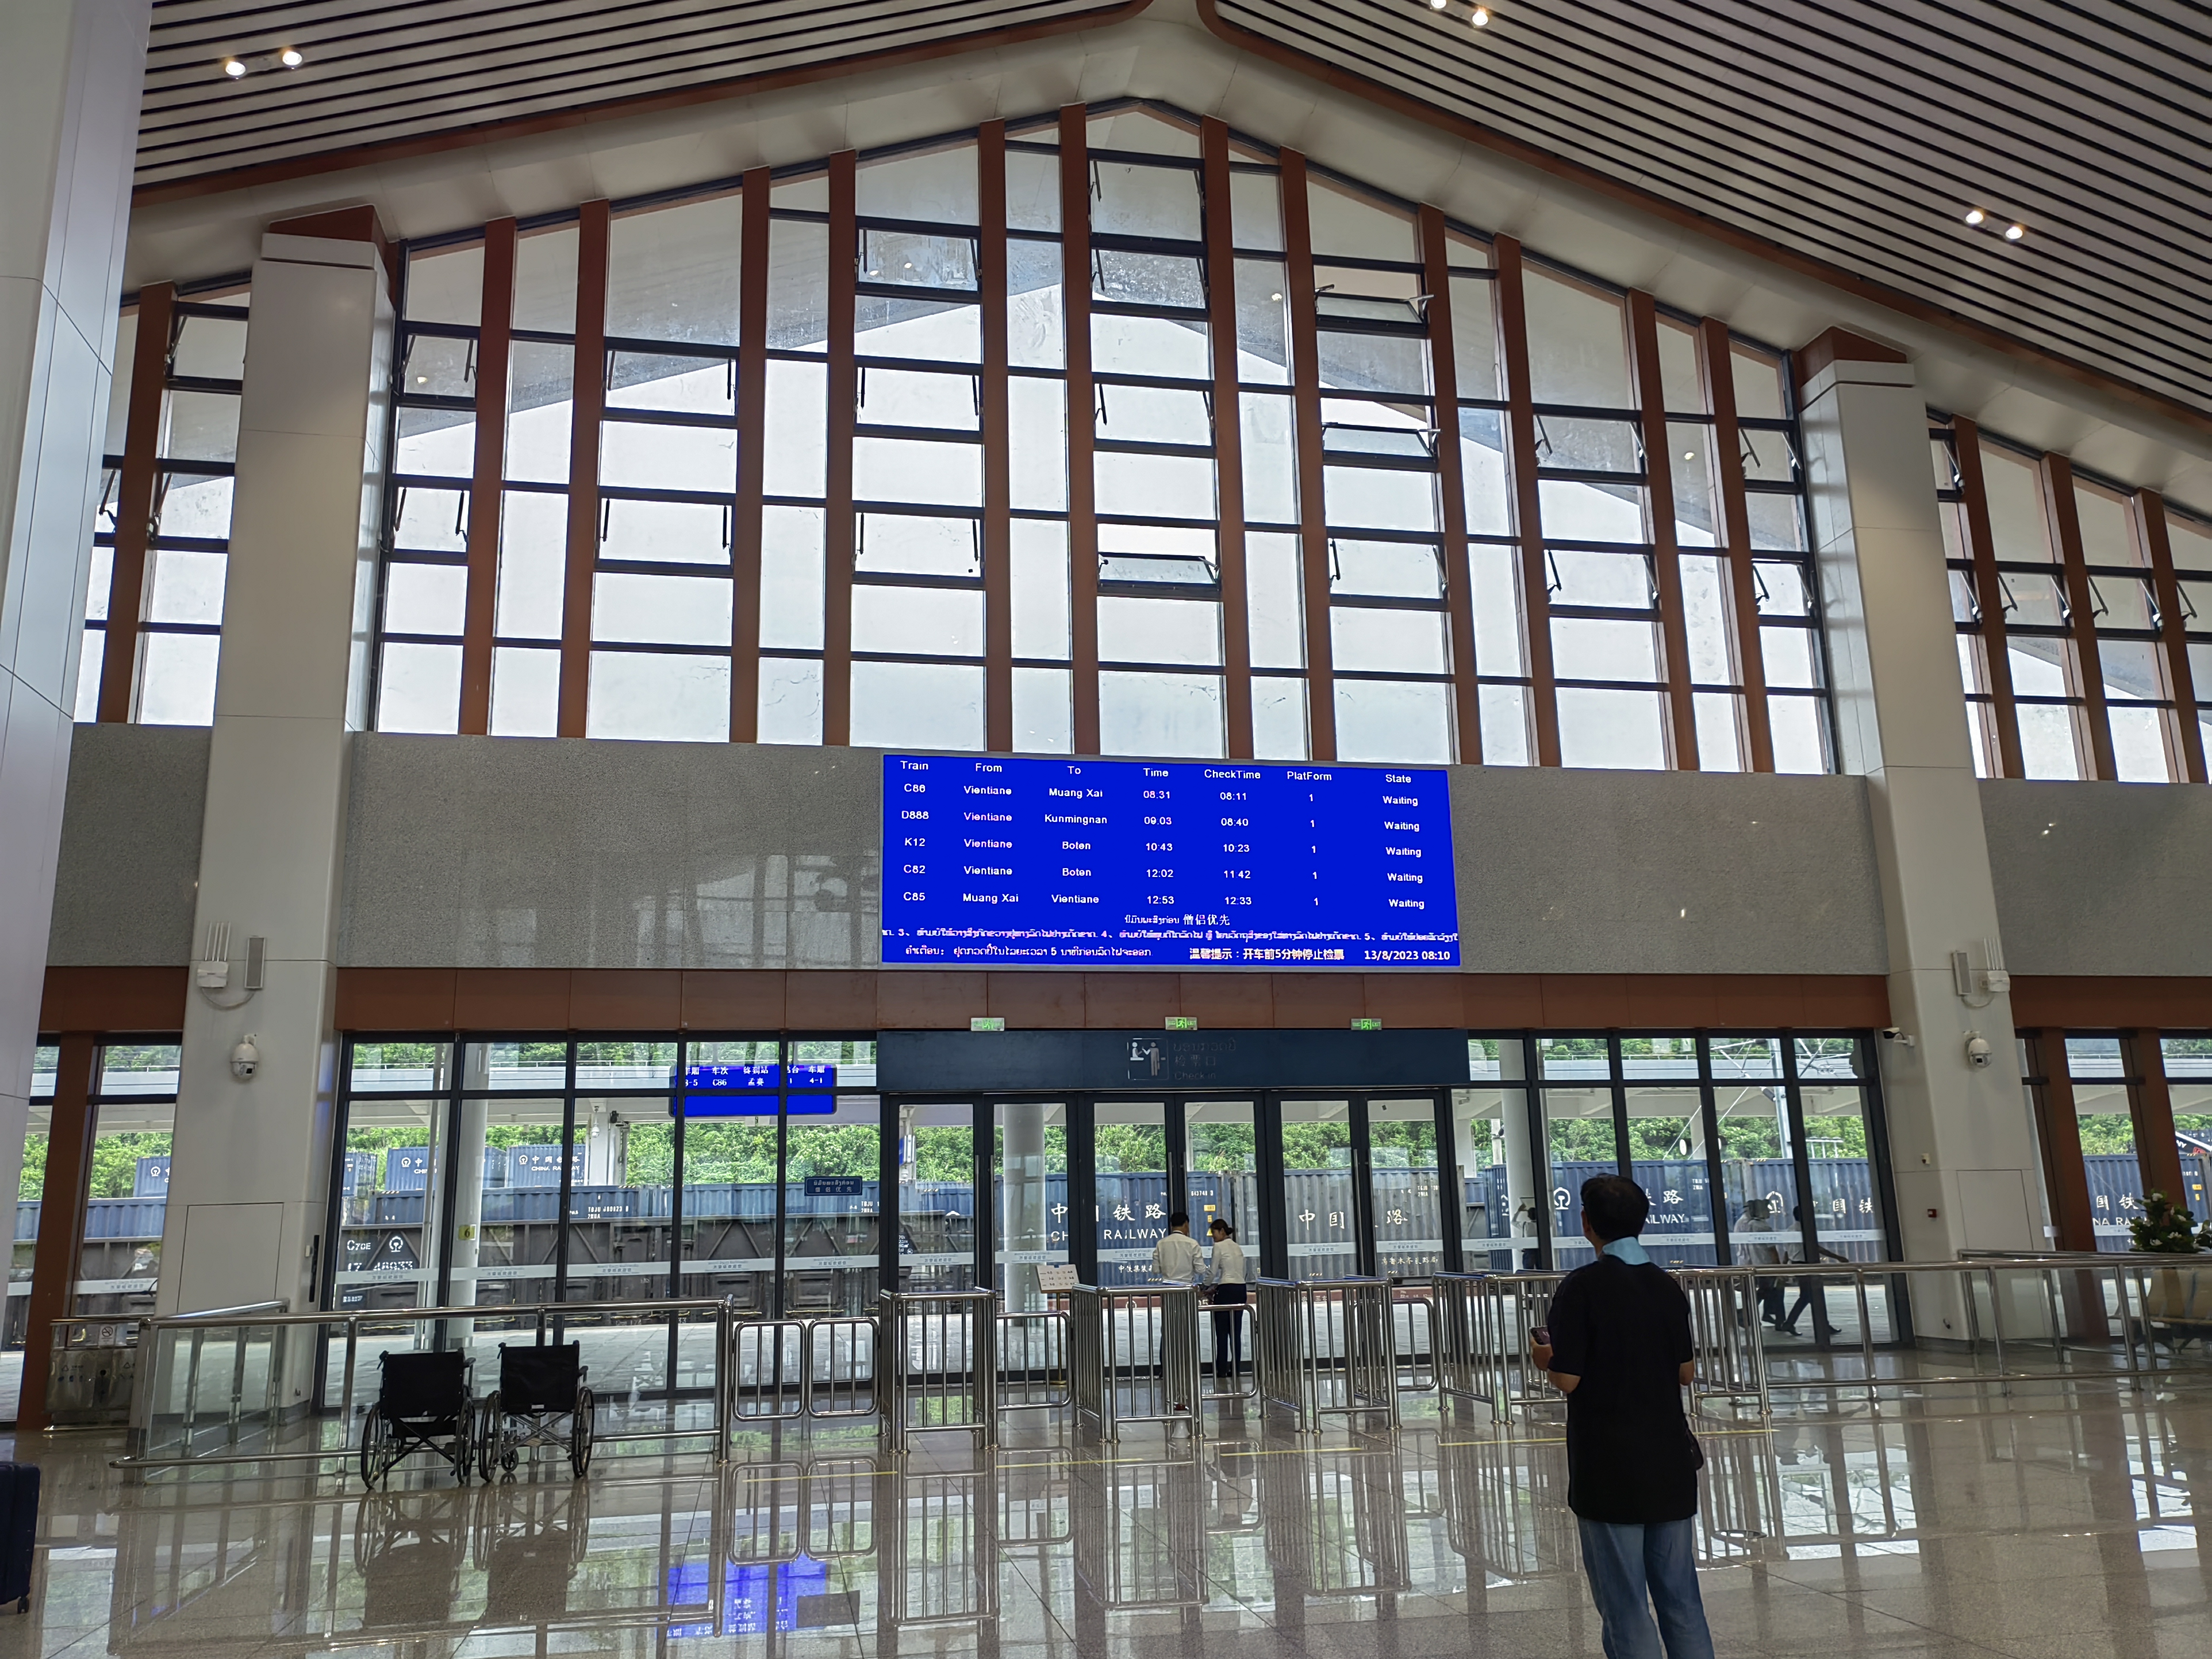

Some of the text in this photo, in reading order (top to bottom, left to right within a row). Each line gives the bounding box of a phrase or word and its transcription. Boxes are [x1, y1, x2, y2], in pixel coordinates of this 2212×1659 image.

[900, 761, 1412, 783] Train From To Time CheckTime PlatForm State
[904, 784, 926, 793] C86
[964, 786, 1012, 795] Vientiane
[1049, 788, 1083, 798] Muang
[1087, 790, 1103, 798] Xai
[1143, 790, 1170, 799] 08:31
[1220, 792, 1246, 800] 08:11
[1382, 796, 1418, 806] Waiting
[901, 811, 929, 819] D888
[964, 812, 1012, 821] Vientiane
[1045, 814, 1107, 826] Kunmingnan
[1144, 817, 1172, 825] 09:03
[1221, 818, 1249, 826] 08:40
[1384, 821, 1420, 832] Waiting
[905, 838, 926, 847] K12
[964, 839, 1013, 848] Vientiane
[1062, 841, 1091, 849] Boten
[1145, 843, 1173, 851] 10:43
[1223, 844, 1250, 852] 10:23
[1386, 847, 1421, 858] Waiting
[903, 865, 926, 874] C82
[964, 866, 1013, 875] Vientiane
[1062, 868, 1091, 876] Boten
[1147, 869, 1174, 878] 12:02
[1224, 871, 1251, 879] 11:42
[1387, 873, 1423, 884] Waiting
[903, 892, 1425, 910] C85 Muang Xai Vientiane 12:53 12:33 1 Waiting
[1183, 914, 1230, 926] 僧侣优先
[1051, 947, 1057, 956] 5
[1364, 950, 1451, 961] 13/8/2023 08:10
[1175, 1054, 1216, 1067] 检票口
[711, 1067, 729, 1075] 车次
[1174, 1071, 1205, 1081] Check
[1051, 1203, 1166, 1223] 中铁路
[1299, 1209, 1408, 1230] 中国路
[464, 1229, 471, 1238] 6
[1103, 1228, 1167, 1240] RAILWAY
